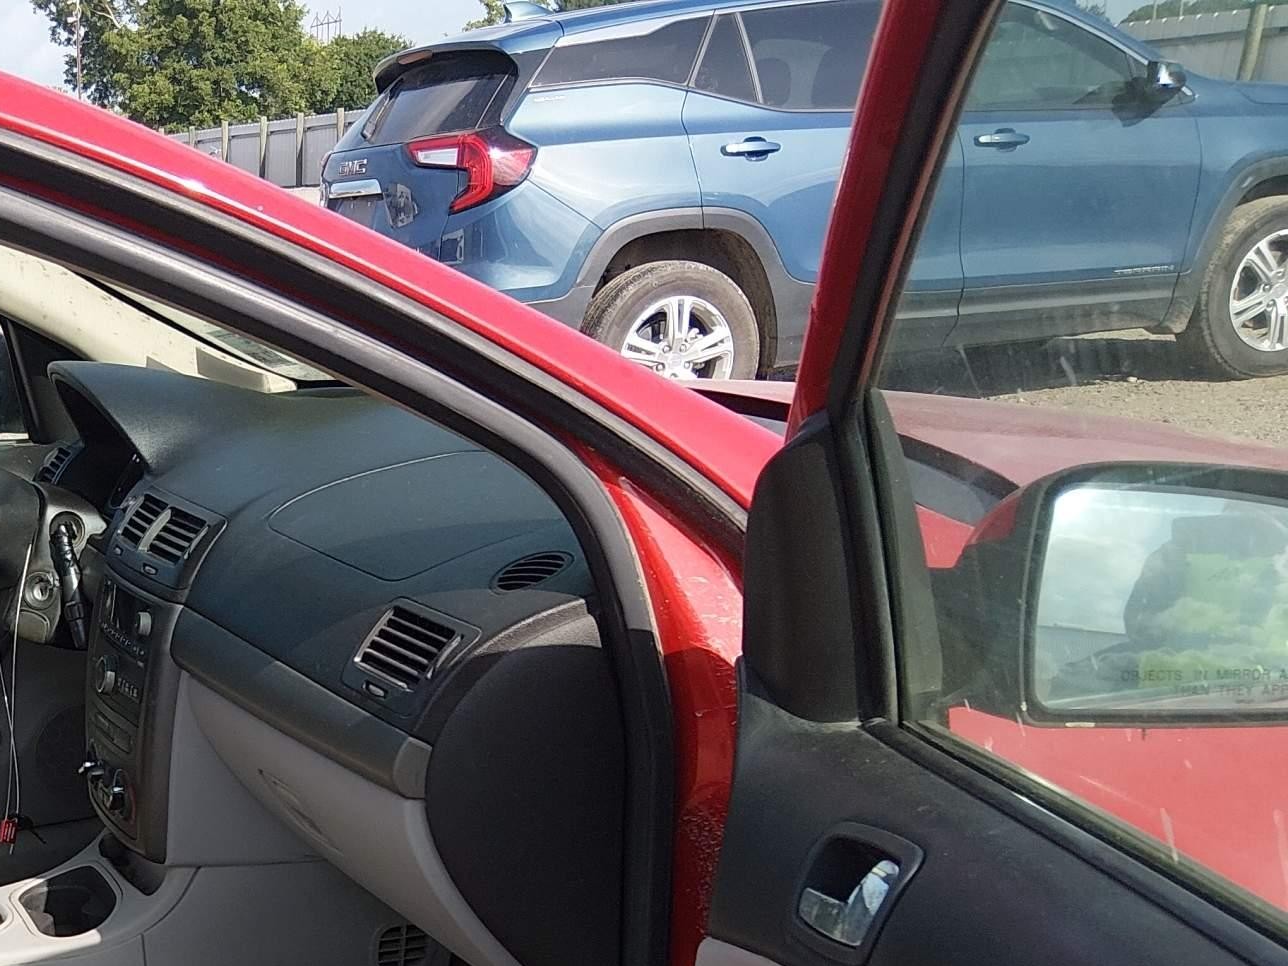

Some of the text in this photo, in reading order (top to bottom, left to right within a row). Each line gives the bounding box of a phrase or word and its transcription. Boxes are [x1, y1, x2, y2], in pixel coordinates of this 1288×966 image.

[339, 159, 368, 175] GMC
[1120, 669, 1183, 681] OBJECTS
[1216, 668, 1271, 680] MIRROR
